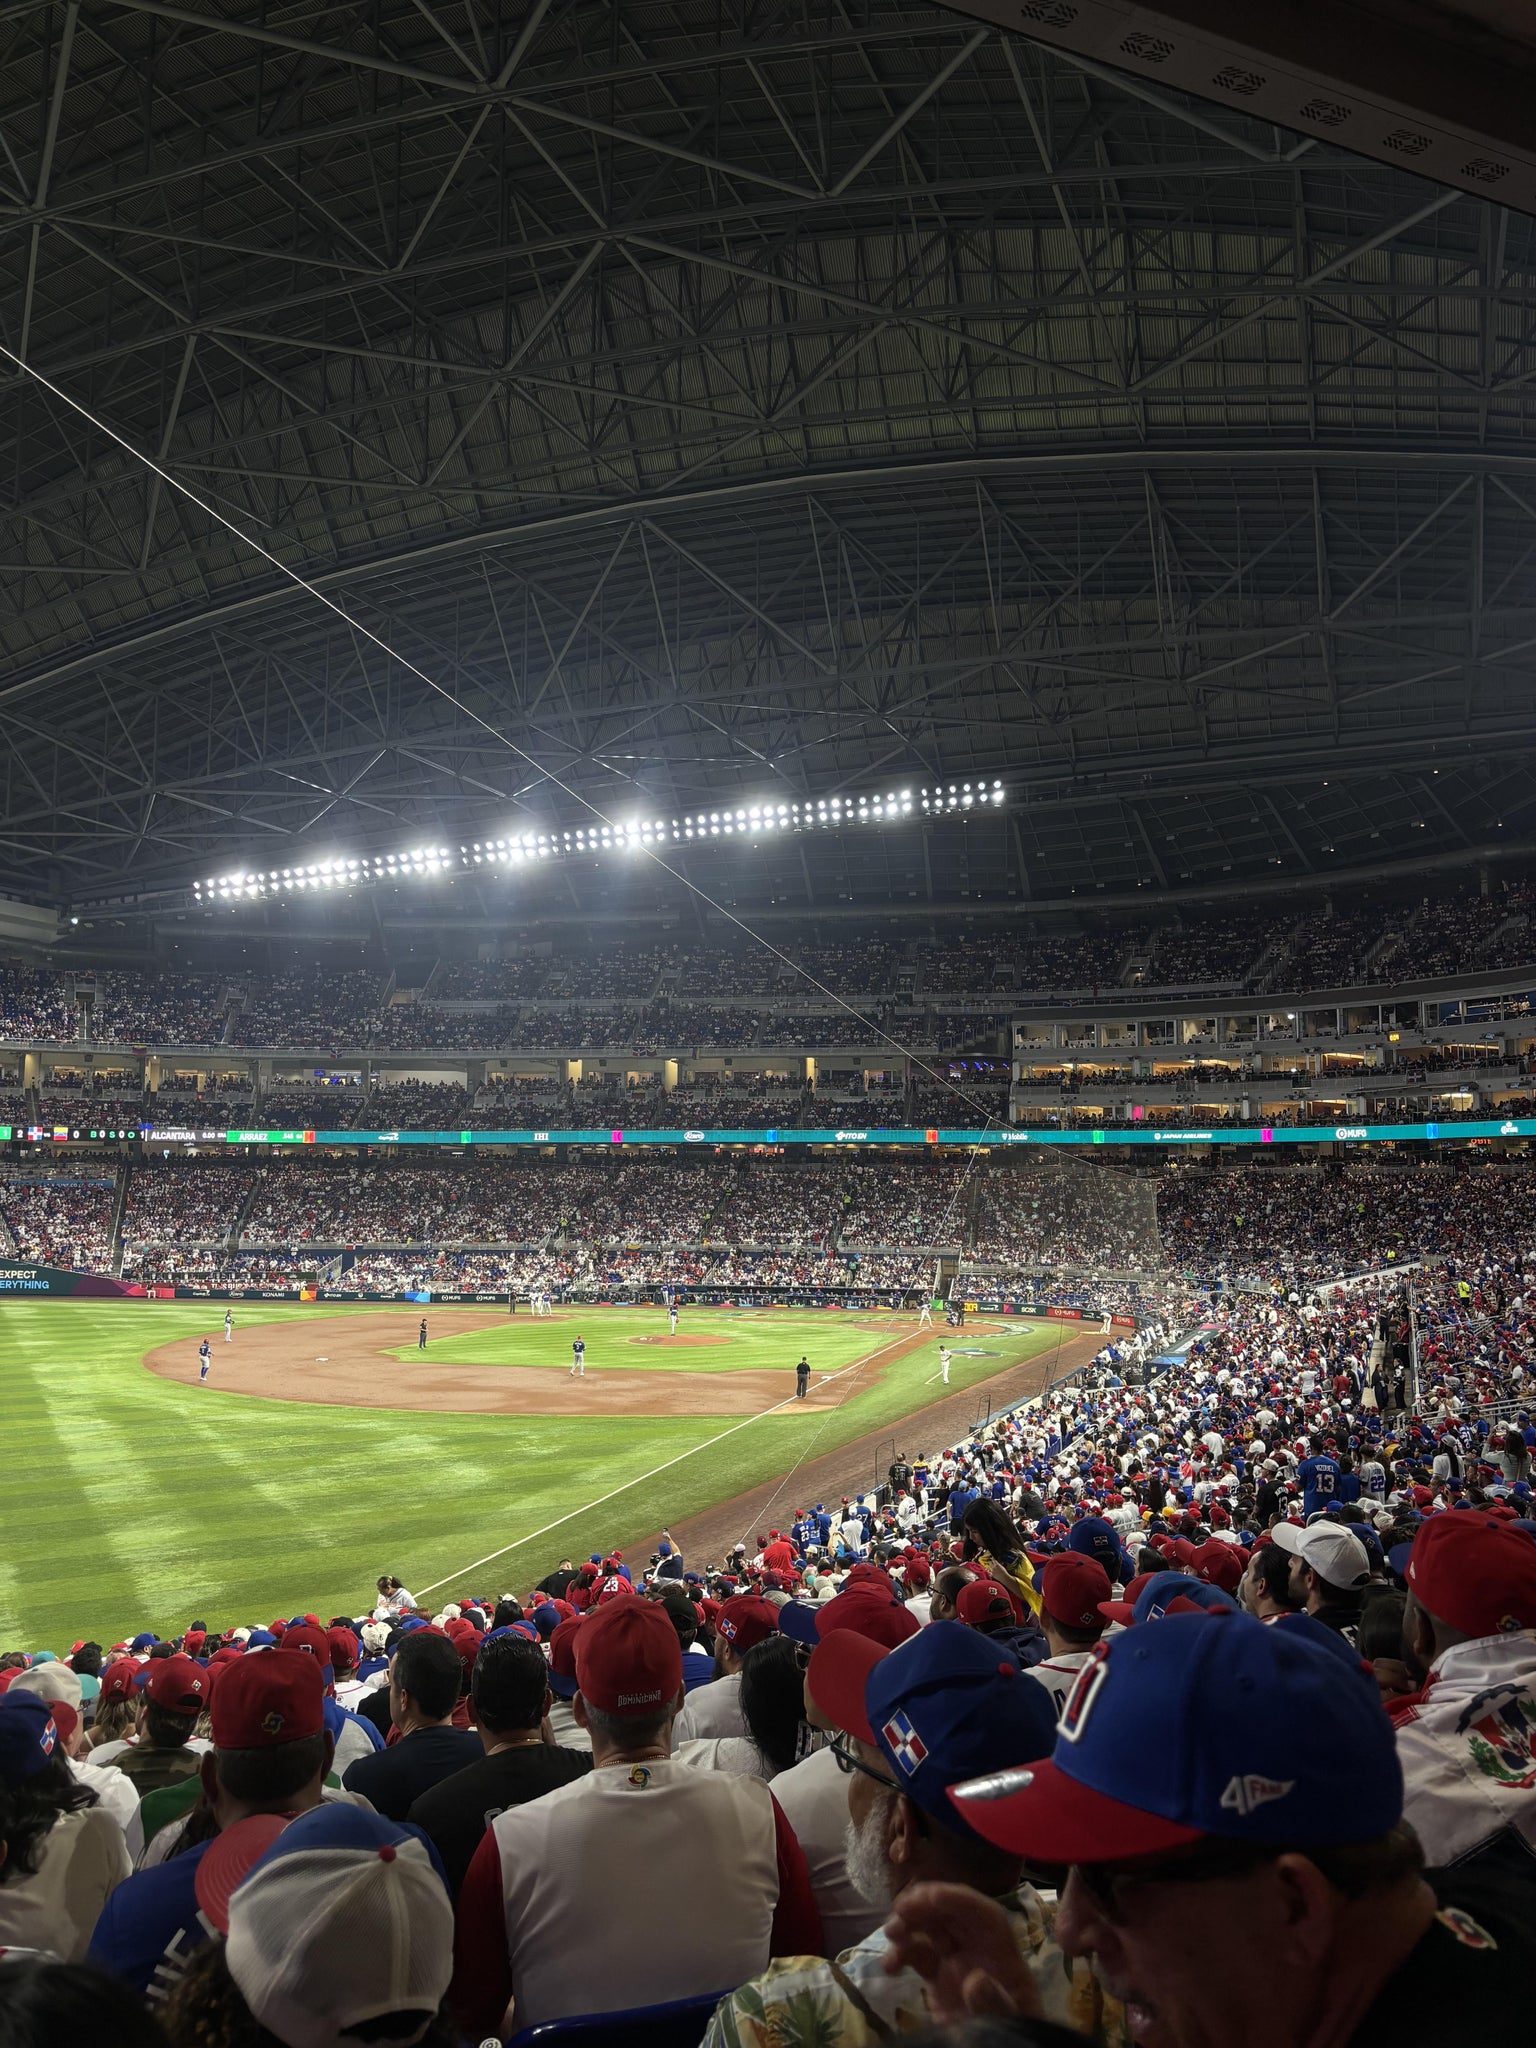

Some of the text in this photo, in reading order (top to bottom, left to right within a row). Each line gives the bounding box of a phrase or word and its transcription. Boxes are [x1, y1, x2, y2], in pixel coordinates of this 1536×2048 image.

[151, 1131, 196, 1140] ALCANTARA
[0, 1270, 37, 1279] EXPECT
[0, 1281, 49, 1289] ERYTHING
[1315, 1473, 1335, 1493] 13
[1370, 1475, 1385, 1492] 22
[603, 1580, 619, 1592] 23
